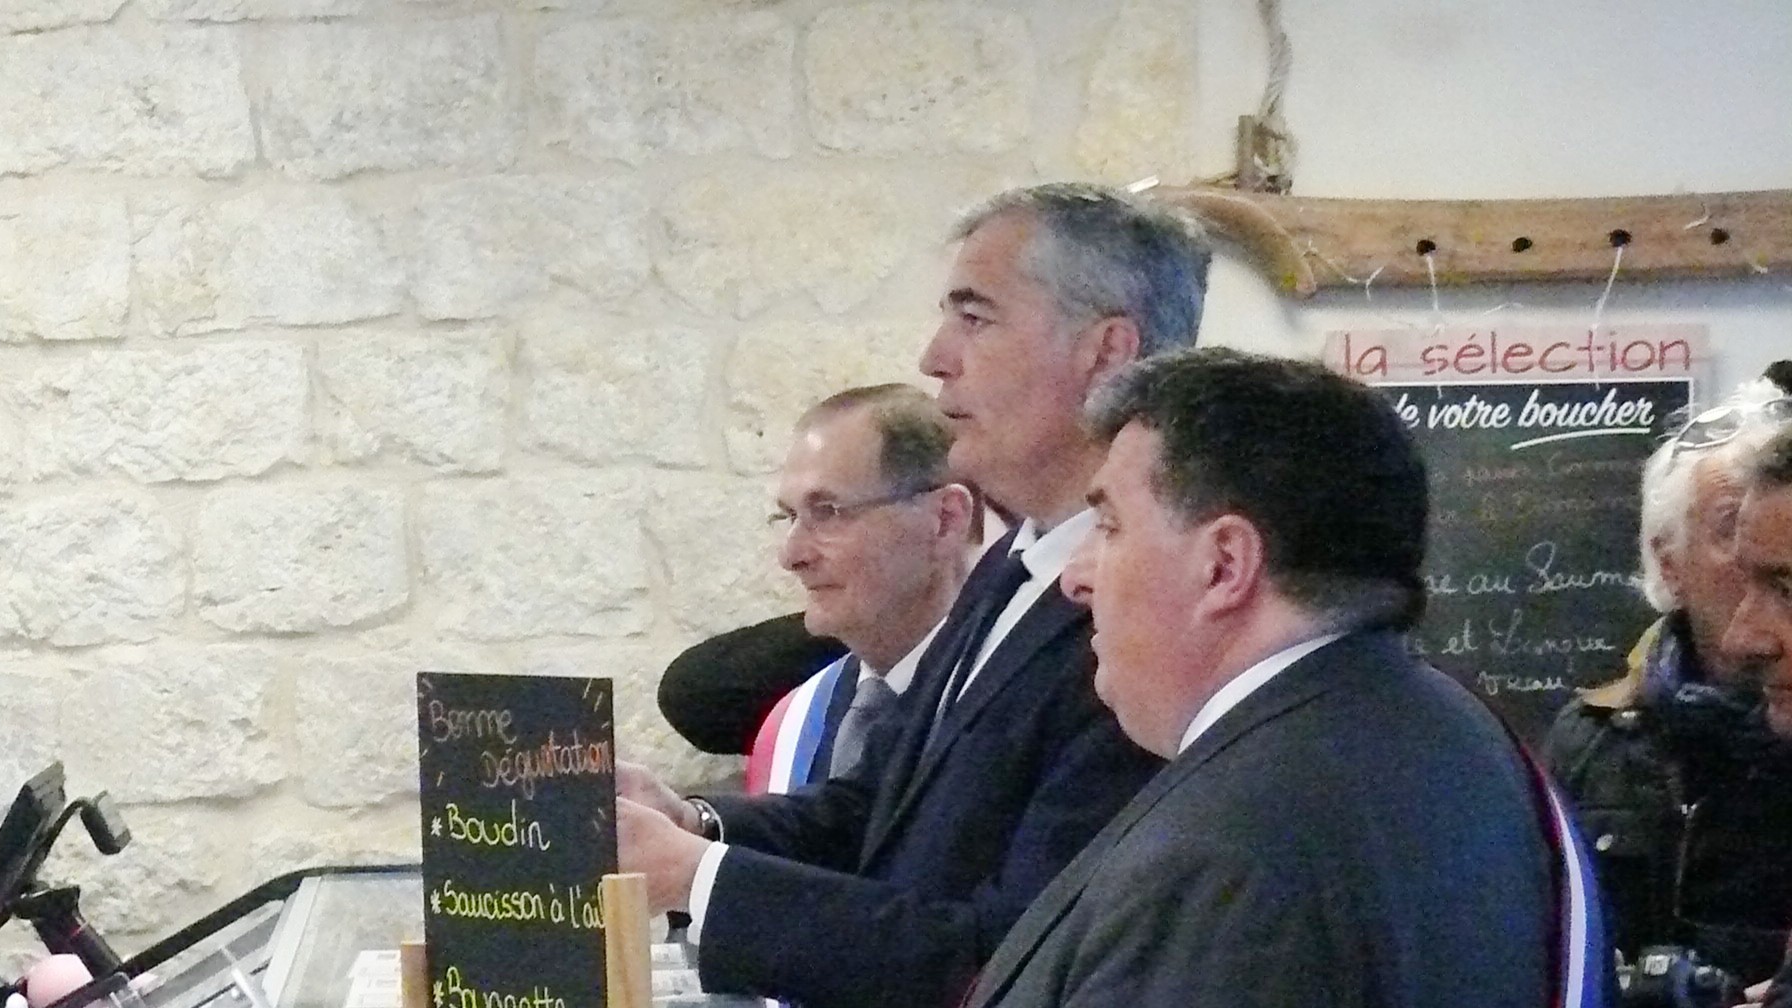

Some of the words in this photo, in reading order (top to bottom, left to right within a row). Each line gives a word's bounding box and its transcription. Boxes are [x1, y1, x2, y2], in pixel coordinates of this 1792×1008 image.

[1344, 333, 1388, 377] la
[1420, 330, 1692, 376] sélection
[1427, 393, 1512, 430] votre
[1518, 388, 1655, 430] boucher
[1467, 573, 1516, 594] au
[1440, 618, 1479, 655] et
[445, 798, 551, 852] Boudin
[443, 879, 544, 921] Saucisson
[549, 882, 566, 924] à
